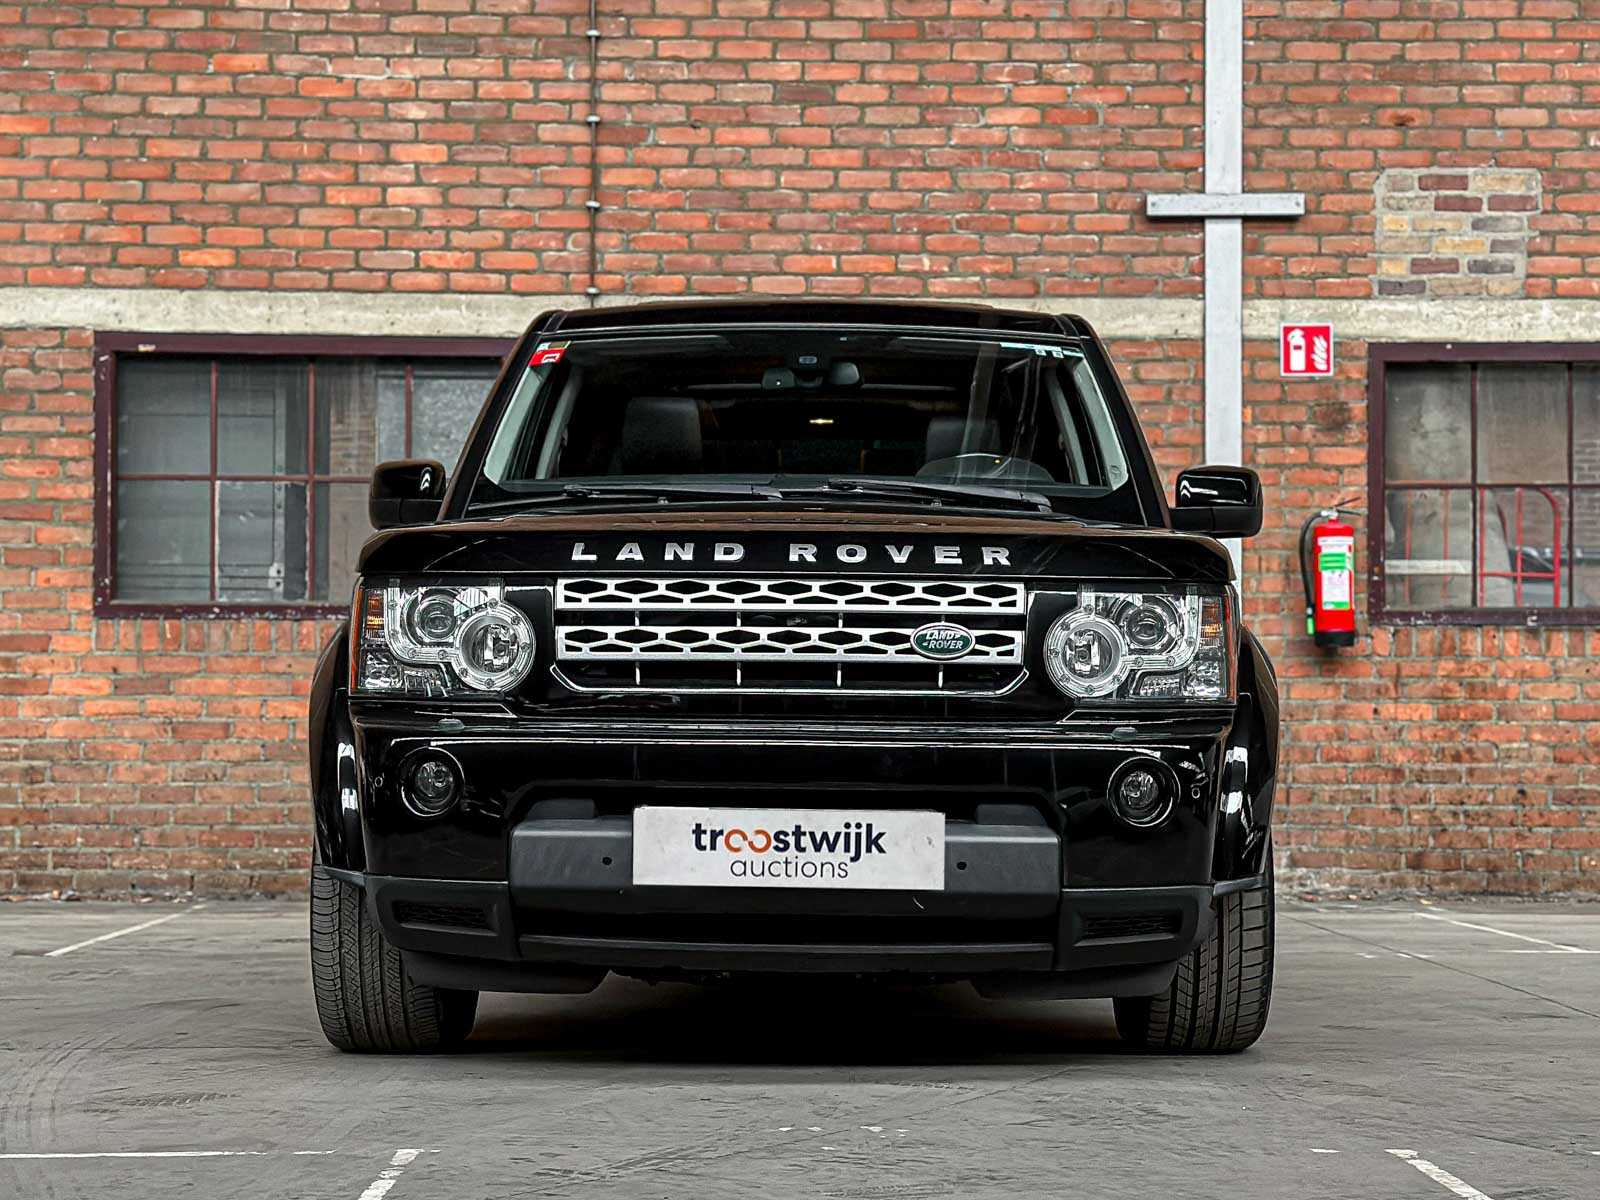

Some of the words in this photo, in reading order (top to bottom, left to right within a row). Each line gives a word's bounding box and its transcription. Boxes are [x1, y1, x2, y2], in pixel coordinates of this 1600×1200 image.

[571, 542, 745, 562] LAND
[788, 543, 1012, 566] ROVER
[926, 630, 955, 639] LAND
[928, 640, 963, 649] ROVER
[692, 822, 887, 863] troostwijk
[730, 856, 849, 879] auctions
